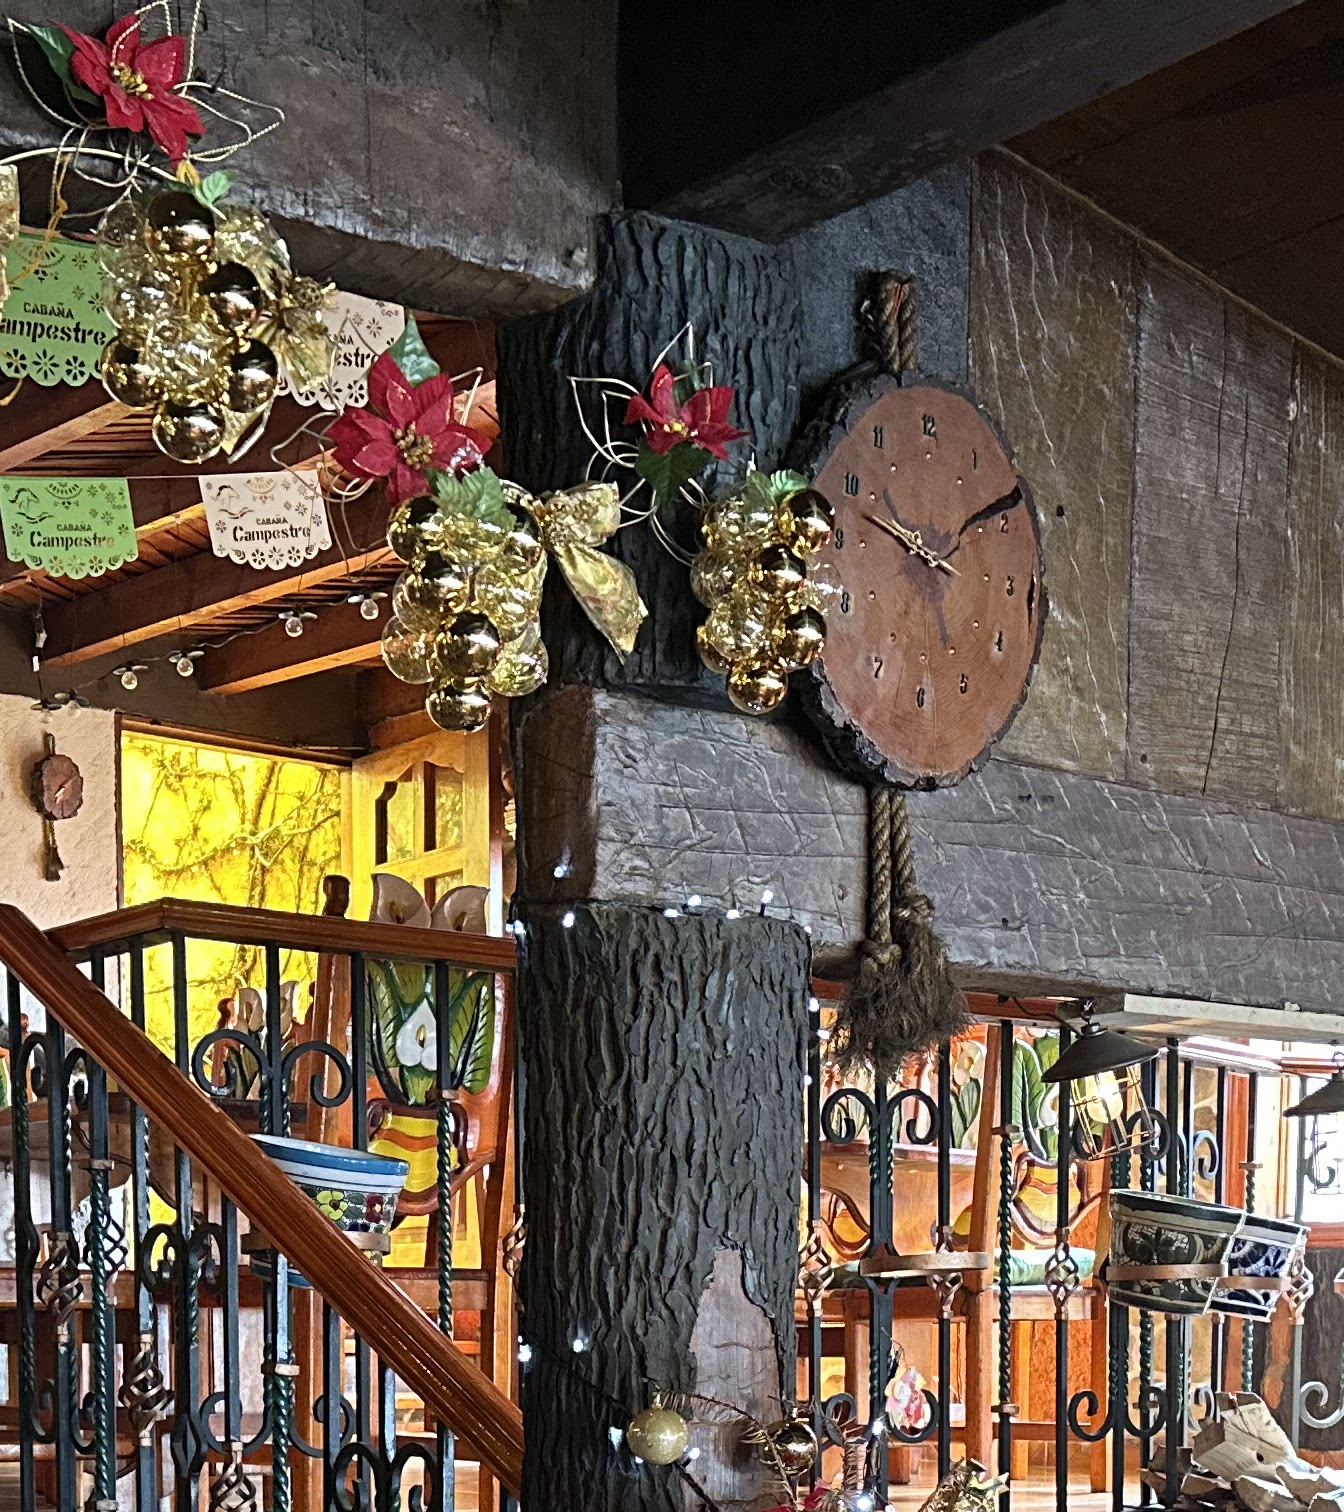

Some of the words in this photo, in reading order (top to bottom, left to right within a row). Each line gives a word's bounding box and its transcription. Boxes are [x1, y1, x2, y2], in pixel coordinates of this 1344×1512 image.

[23, 302, 74, 320] CABAÑA
[922, 413, 937, 437] 12
[873, 425, 883, 449] 11
[845, 472, 859, 496] 10
[233, 524, 310, 543] Campestre
[1000, 512, 1009, 534] 2
[30, 530, 115, 551] Campestre
[835, 528, 844, 550] 9
[1007, 575, 1015, 597] 3
[841, 592, 850, 614] 8
[996, 630, 1003, 652] 4
[874, 656, 883, 679] 7
[959, 673, 968, 694] 5
[916, 687, 925, 709] 6
